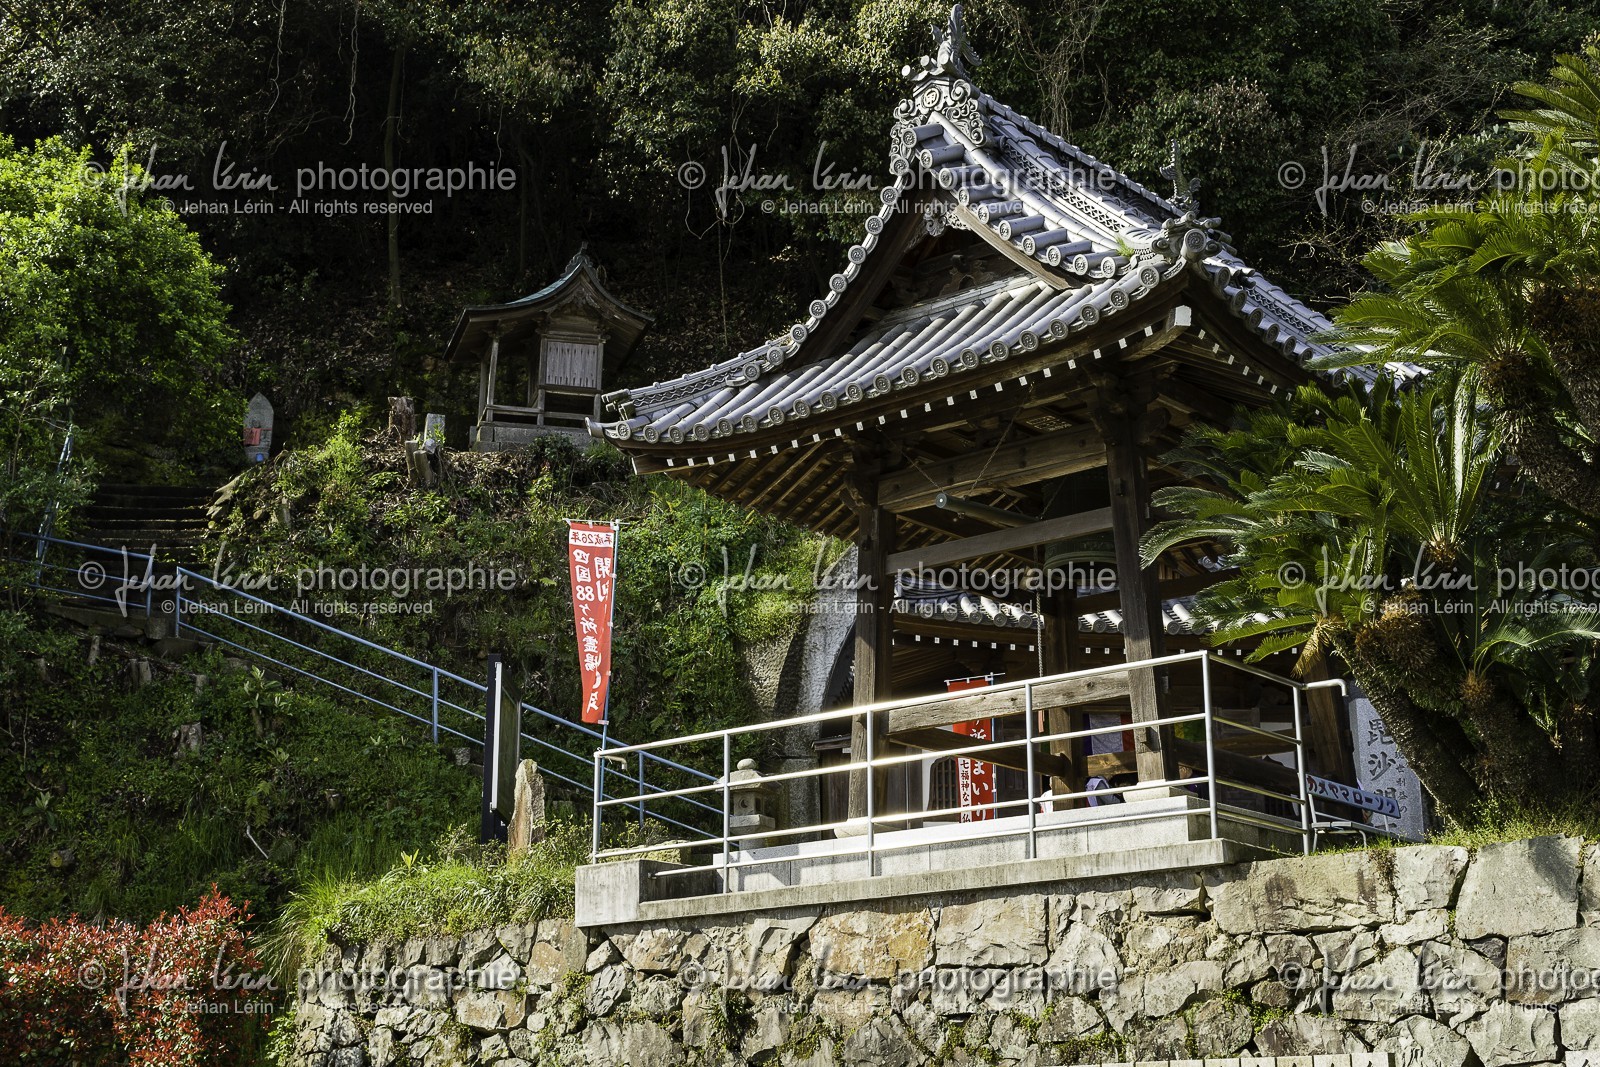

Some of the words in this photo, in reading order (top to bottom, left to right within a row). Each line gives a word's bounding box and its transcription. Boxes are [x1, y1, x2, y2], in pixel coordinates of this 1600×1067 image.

[960, 759, 971, 823] 七福神な仏
